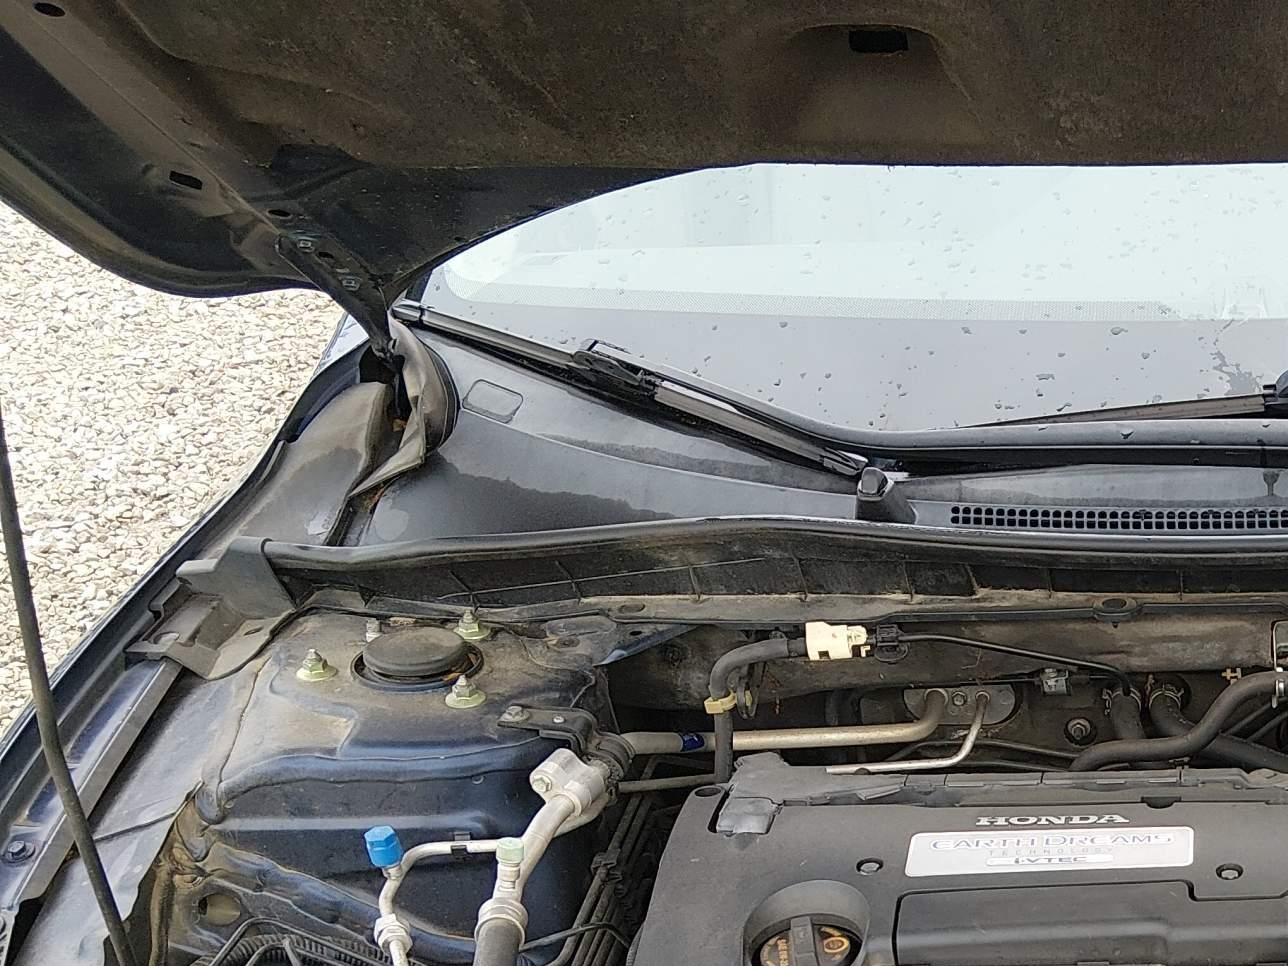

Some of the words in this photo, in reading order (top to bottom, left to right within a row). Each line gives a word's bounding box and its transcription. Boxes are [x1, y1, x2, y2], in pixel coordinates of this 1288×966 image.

[976, 814, 1130, 826] HONDA
[931, 837, 1035, 850] EARTH
[1044, 833, 1173, 847] DREAMS
